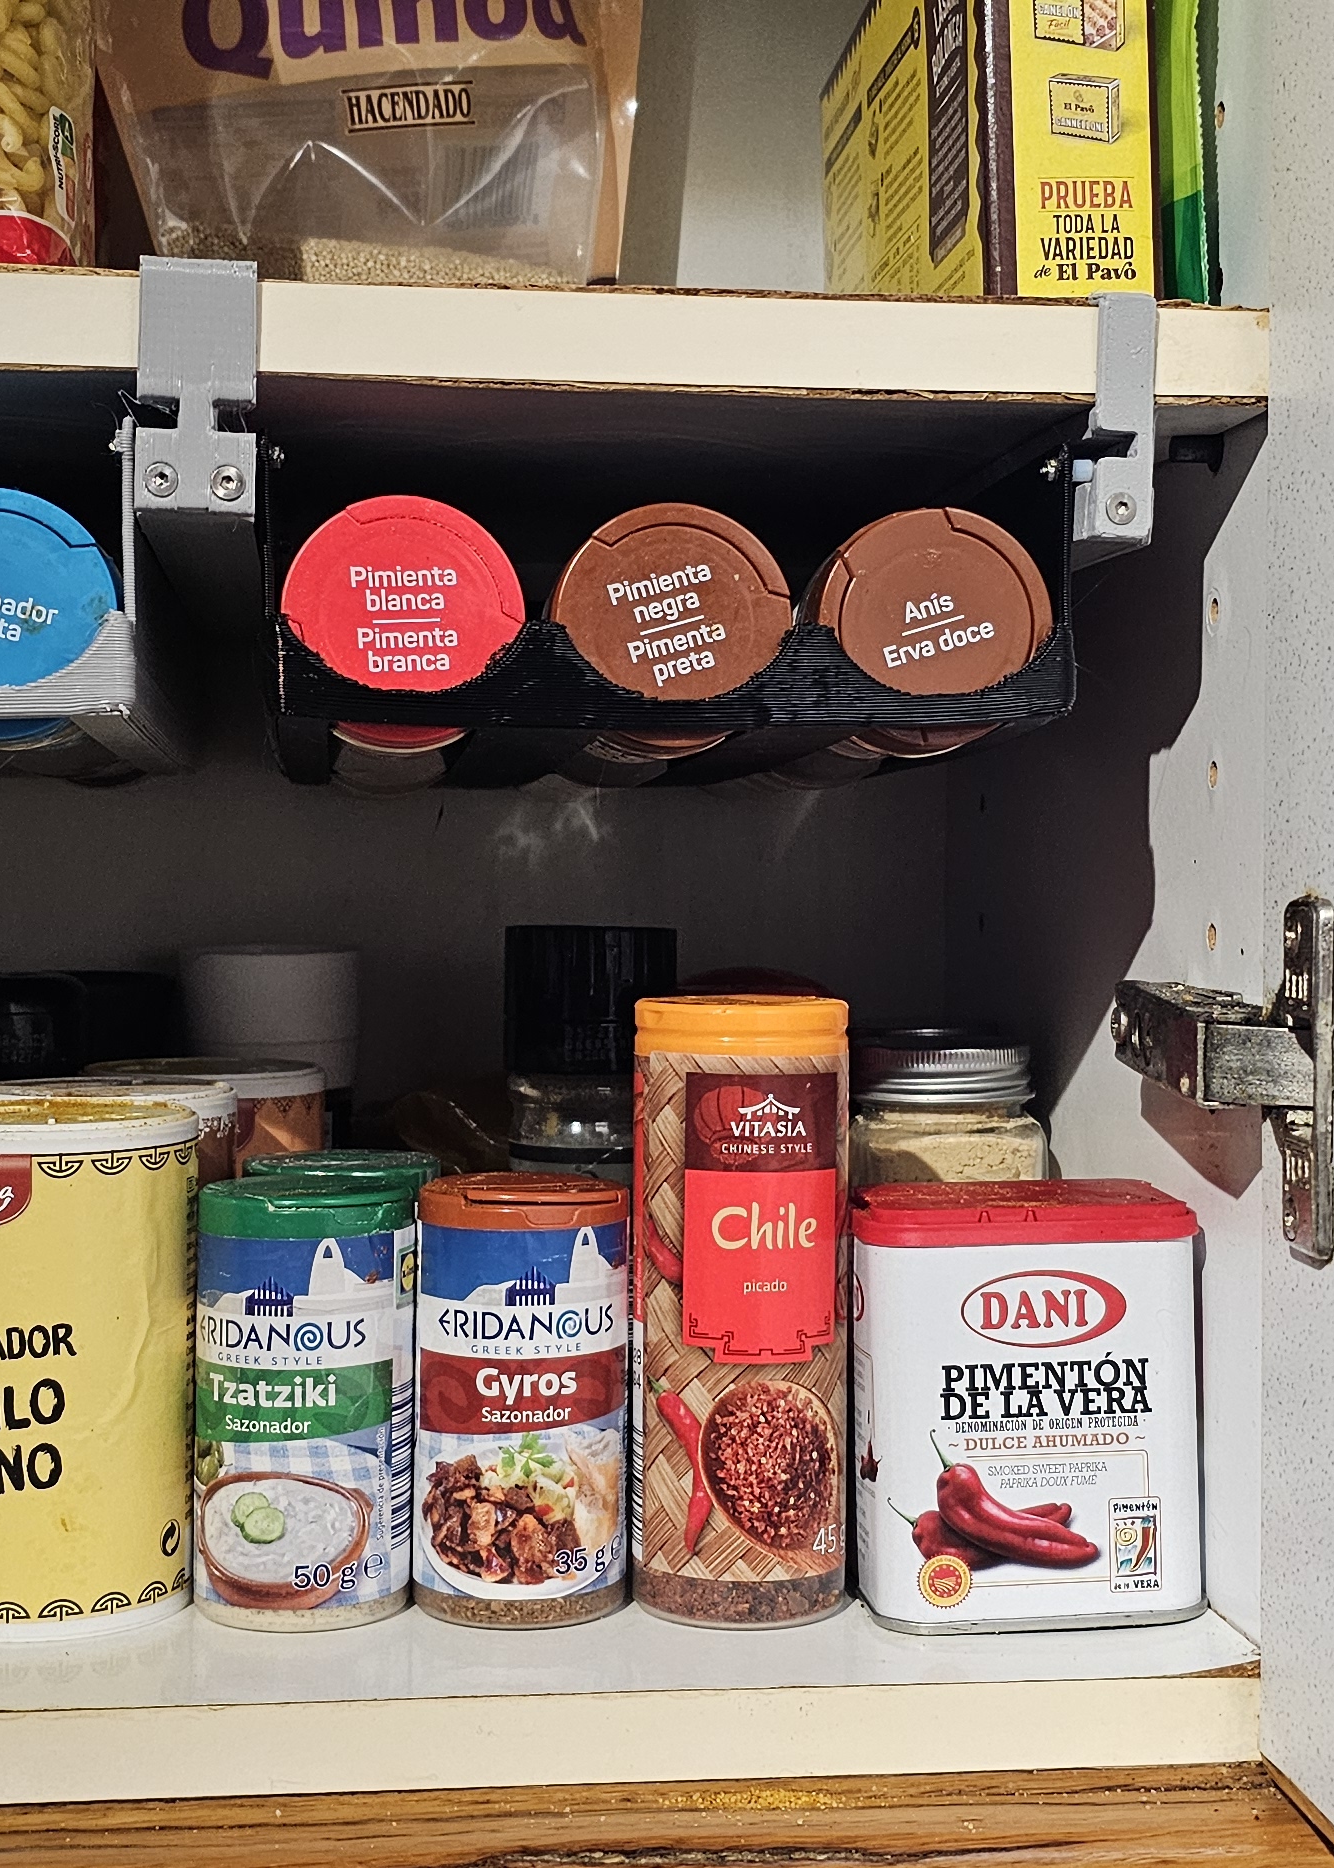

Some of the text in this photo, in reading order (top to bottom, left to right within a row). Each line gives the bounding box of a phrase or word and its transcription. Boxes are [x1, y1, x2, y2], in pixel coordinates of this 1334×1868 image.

[346, 87, 472, 128] HACENDADO
[1063, 102, 1073, 111] El
[52, 113, 65, 191] NUTRI-SCORE
[1039, 180, 1133, 210] PRUEBA
[1053, 214, 1121, 234] TODA LA
[1039, 236, 1134, 260] VARIEDAD
[1033, 264, 1052, 278] de
[1056, 263, 1079, 281] El
[349, 566, 457, 588] Pimienta
[607, 563, 712, 606] Pimienta
[365, 589, 445, 612] blanca
[633, 591, 701, 624] negra
[903, 593, 955, 624] Anís
[357, 627, 458, 650] Pimenta
[627, 621, 727, 663] Pimenta
[883, 620, 995, 670] Erva doce
[367, 650, 451, 672] branca
[652, 650, 716, 687] preta
[729, 1119, 807, 1138] VITASIA
[721, 1142, 813, 1154] CHINESE STYLE
[712, 1202, 817, 1250] Chile
[743, 1278, 787, 1296] picado
[979, 1289, 1089, 1330] DANI
[217, 1352, 323, 1366] GREEK STYLE
[470, 1342, 582, 1356] GREEK STYLE
[941, 1352, 1149, 1392] PIMENTÓN
[209, 1372, 337, 1408] Tzatziki
[475, 1367, 578, 1407] Gyros
[481, 1405, 571, 1425] Sazonador
[940, 1386, 1153, 1422] DE LA VERA
[225, 1415, 312, 1434] Sazonador
[1032, 1420, 1044, 1431] DE
[1049, 1418, 1083, 1430] ORIGEN
[1088, 1415, 1139, 1428] PROTEGIDA
[964, 1432, 1130, 1451] DULCE AHUMADO
[987, 1462, 1107, 1476] SMOKED SWEET PAPRIKA
[999, 1473, 1097, 1488] PAPRIKA DOUX FUMÉ
[375, 1427, 385, 1540] Sugerencia de presentación
[813, 1524, 837, 1556] 45
[553, 1546, 589, 1576] 35
[593, 1547, 607, 1572] g
[292, 1562, 333, 1590] 50
[337, 1560, 358, 1590] g
[1133, 1578, 1159, 1588] VERA
